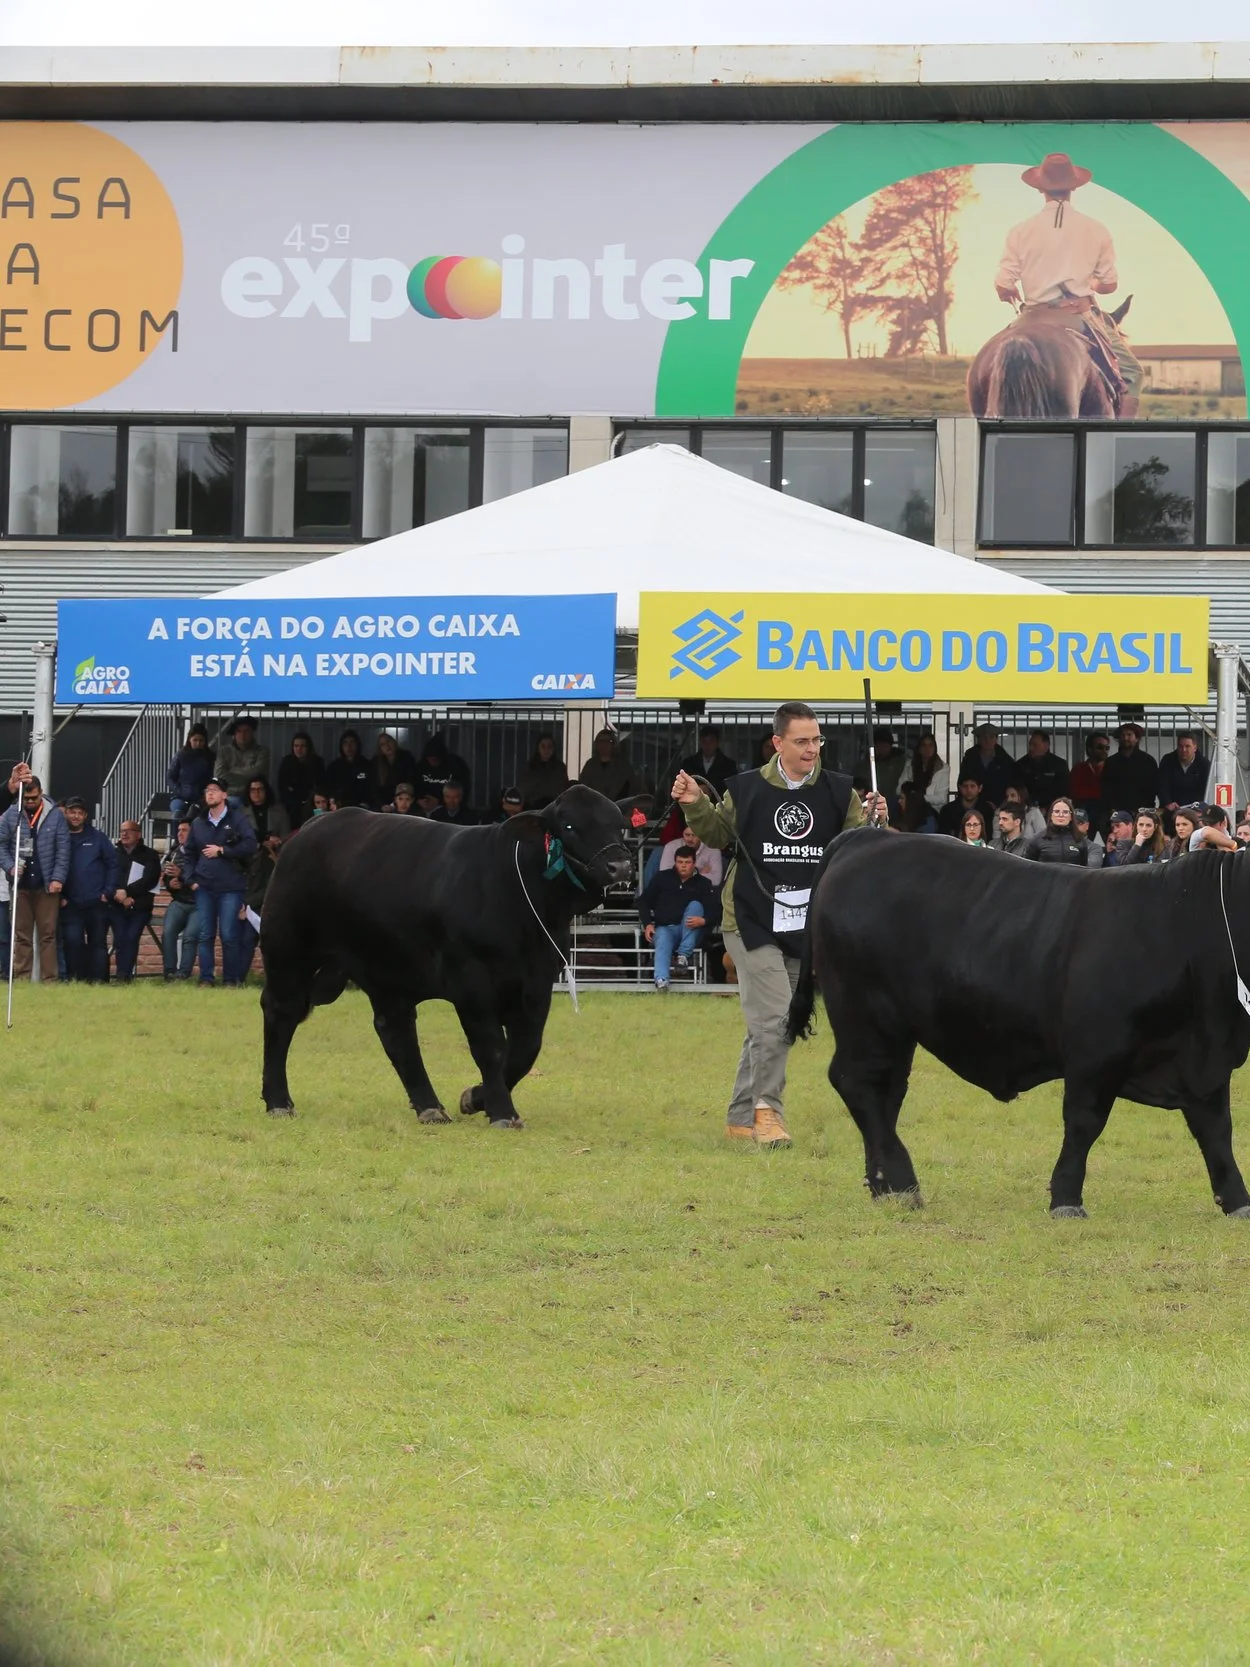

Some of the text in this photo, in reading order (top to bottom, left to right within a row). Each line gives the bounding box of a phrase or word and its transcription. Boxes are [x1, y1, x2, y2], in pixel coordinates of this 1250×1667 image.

[1, 177, 131, 219] ASA
[7, 243, 40, 285] A
[0, 309, 179, 352] ECOM
[147, 614, 521, 646] A FORÇA DO AGRO CAIXA
[190, 646, 477, 677] ESTÁ NA EXPOINTER
[756, 620, 1193, 675] BANCO DO BRASIL
[75, 680, 130, 695] CAIXA
[80, 665, 130, 681] AGRO
[531, 673, 596, 690] CAIXA
[762, 842, 824, 858] Brangus
